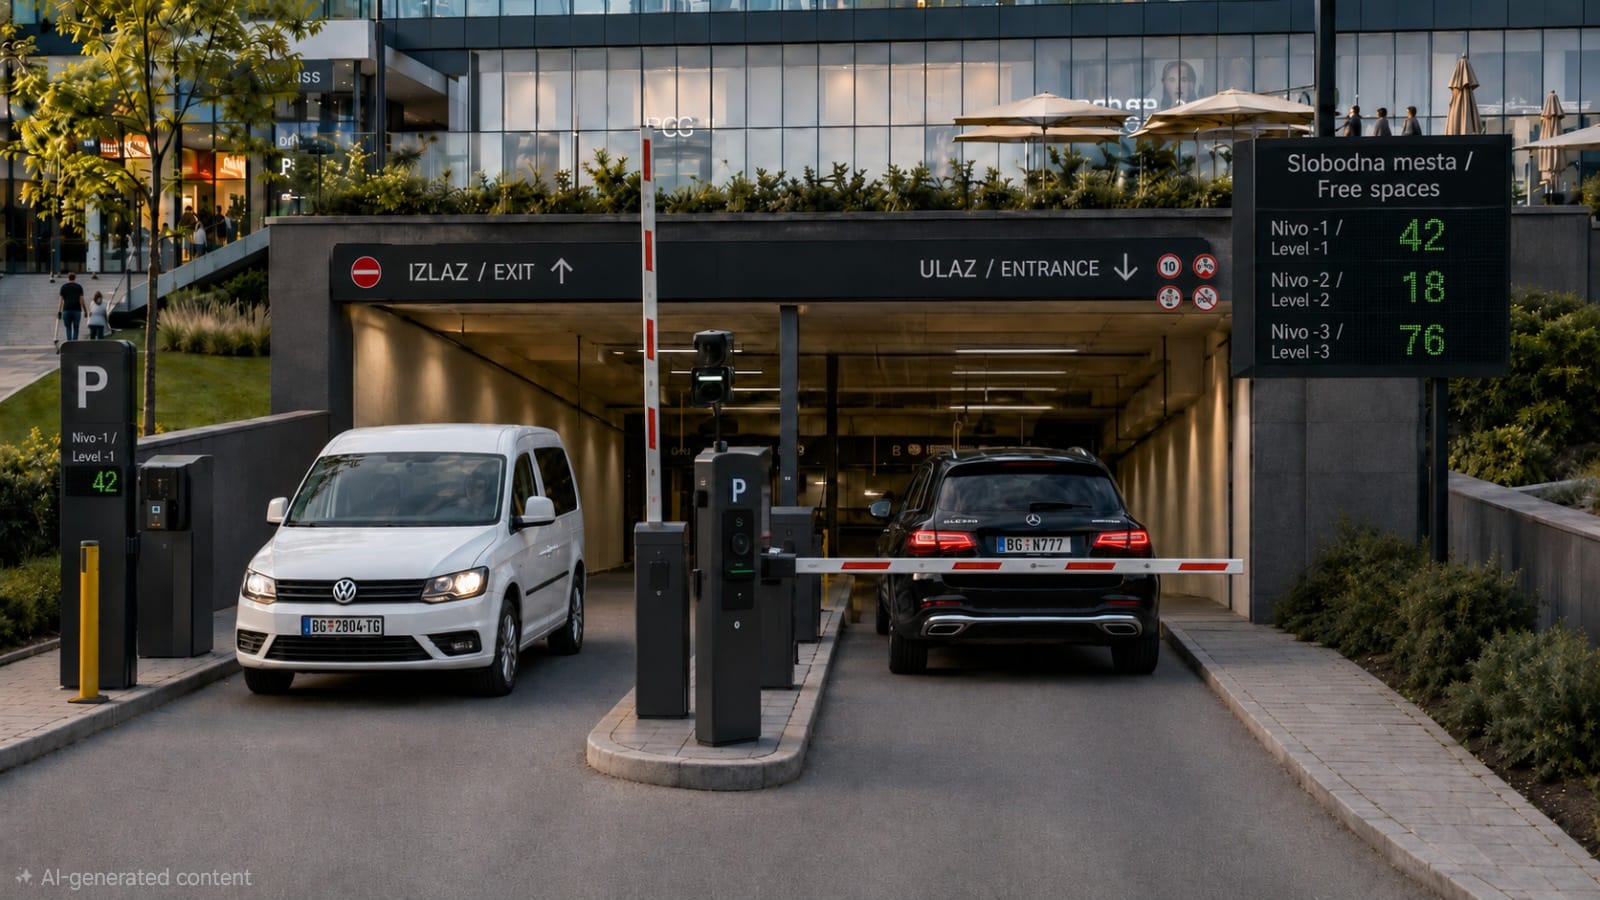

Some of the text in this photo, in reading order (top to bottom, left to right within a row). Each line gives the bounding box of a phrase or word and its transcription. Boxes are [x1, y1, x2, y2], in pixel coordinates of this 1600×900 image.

[1287, 151, 1474, 172] Slobodna mesta /
[1318, 179, 1440, 202] Free spaces
[1271, 219, 1343, 236] Nivo -1 /
[1399, 218, 1445, 251] 42
[1271, 241, 1328, 256] Level -1
[409, 262, 535, 282] IZLAZ / EXIT
[919, 258, 1100, 279] ULAZ / ENTRANCE
[1163, 261, 1177, 272] 10
[1271, 271, 1343, 288] Nivo -2 /
[1403, 270, 1445, 303] 18
[1271, 292, 1330, 307] Level -2
[1271, 323, 1344, 340] Nivo -3 /
[1399, 324, 1445, 356] 76
[1271, 344, 1330, 359] Level -3
[77, 365, 108, 408] P
[72, 432, 96, 443] Nivo
[111, 432, 117, 444] /
[72, 451, 114, 462] Level -1
[92, 471, 118, 493] 42
[732, 478, 746, 502] P
[1006, 538, 1063, 551] BG N777
[312, 619, 327, 633] BG
